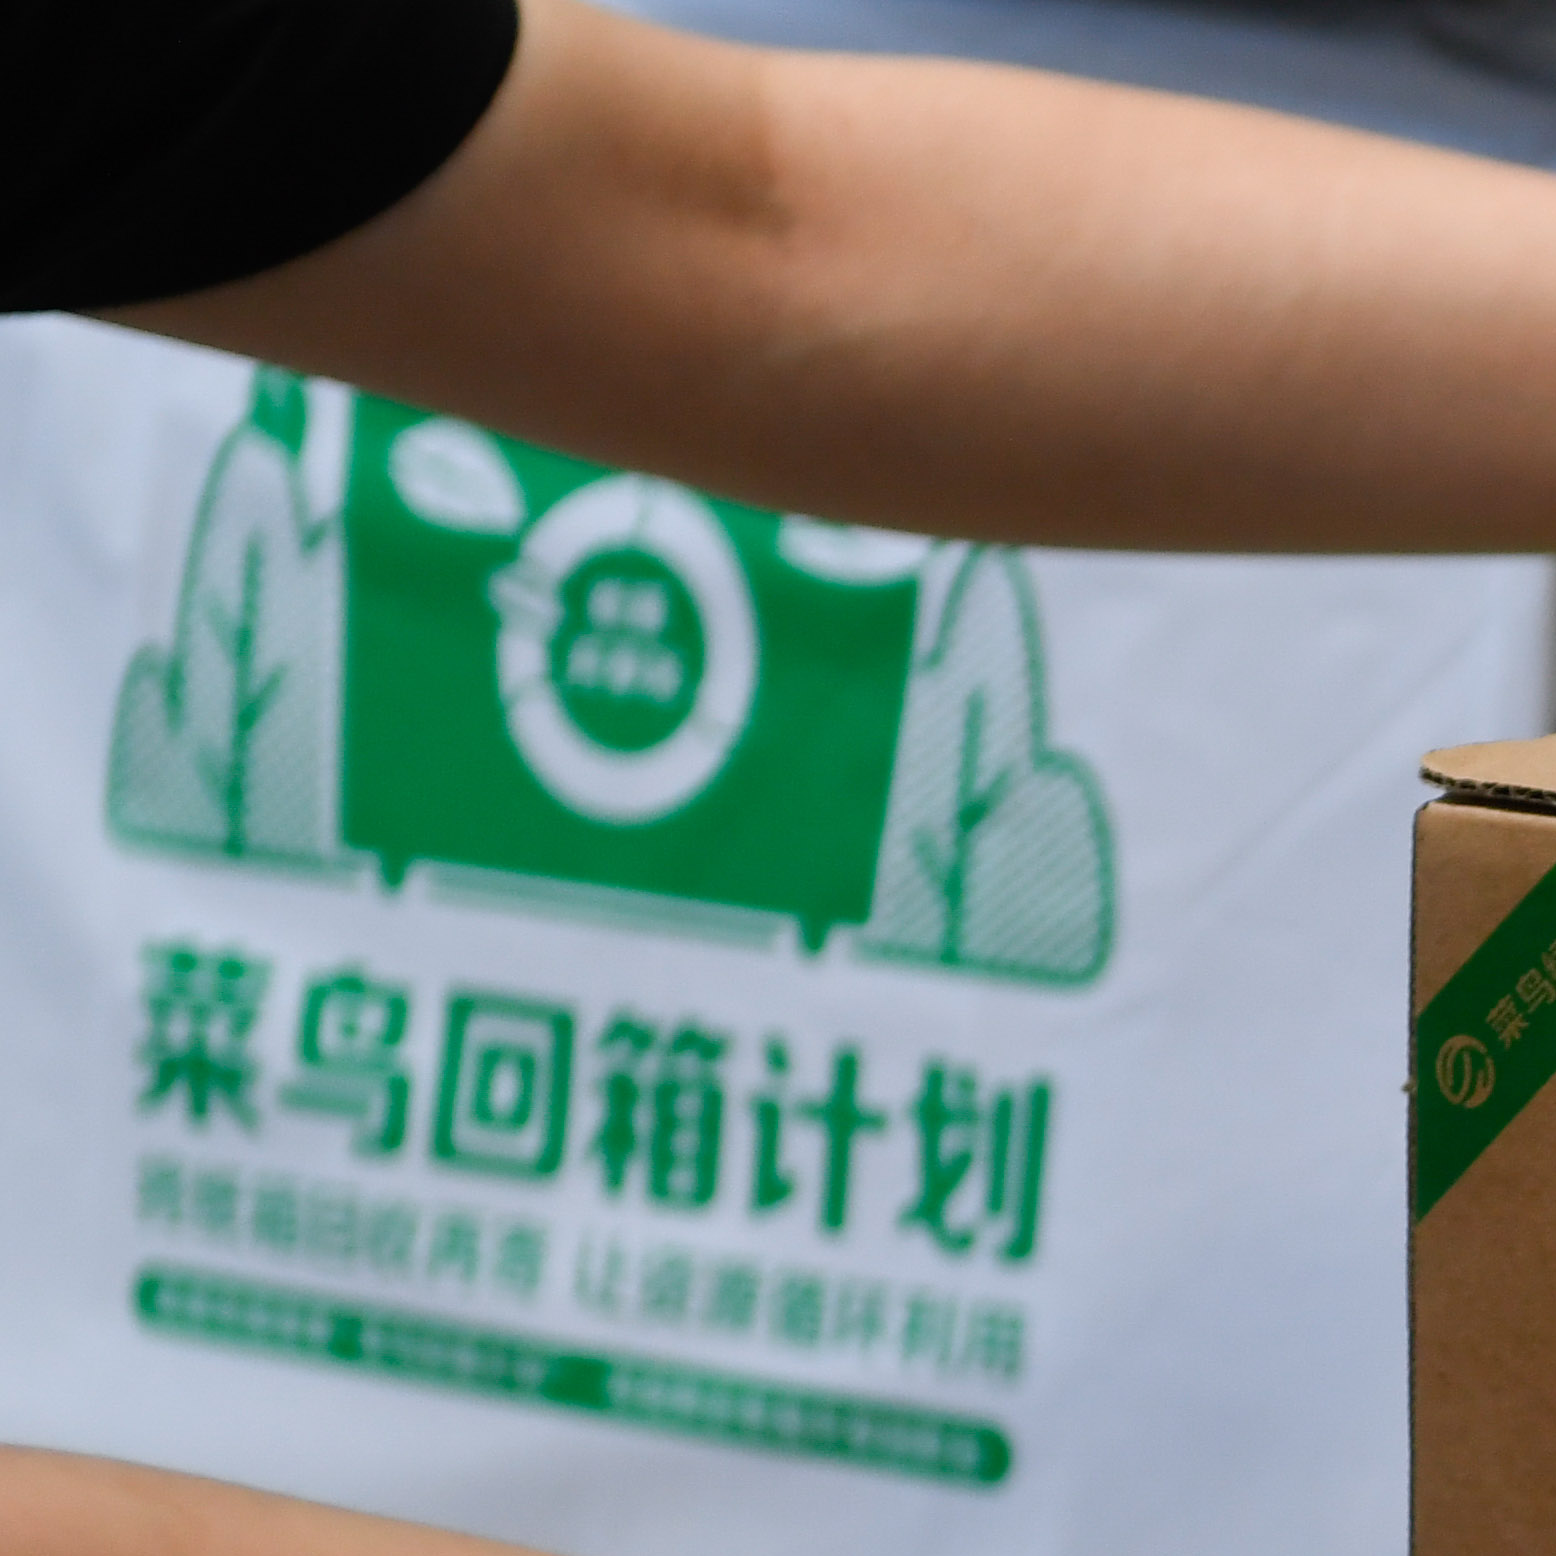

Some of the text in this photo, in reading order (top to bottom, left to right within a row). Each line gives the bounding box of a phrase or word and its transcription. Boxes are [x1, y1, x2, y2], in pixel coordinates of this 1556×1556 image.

[133, 934, 1056, 1264] 菜鸟回箱计划
